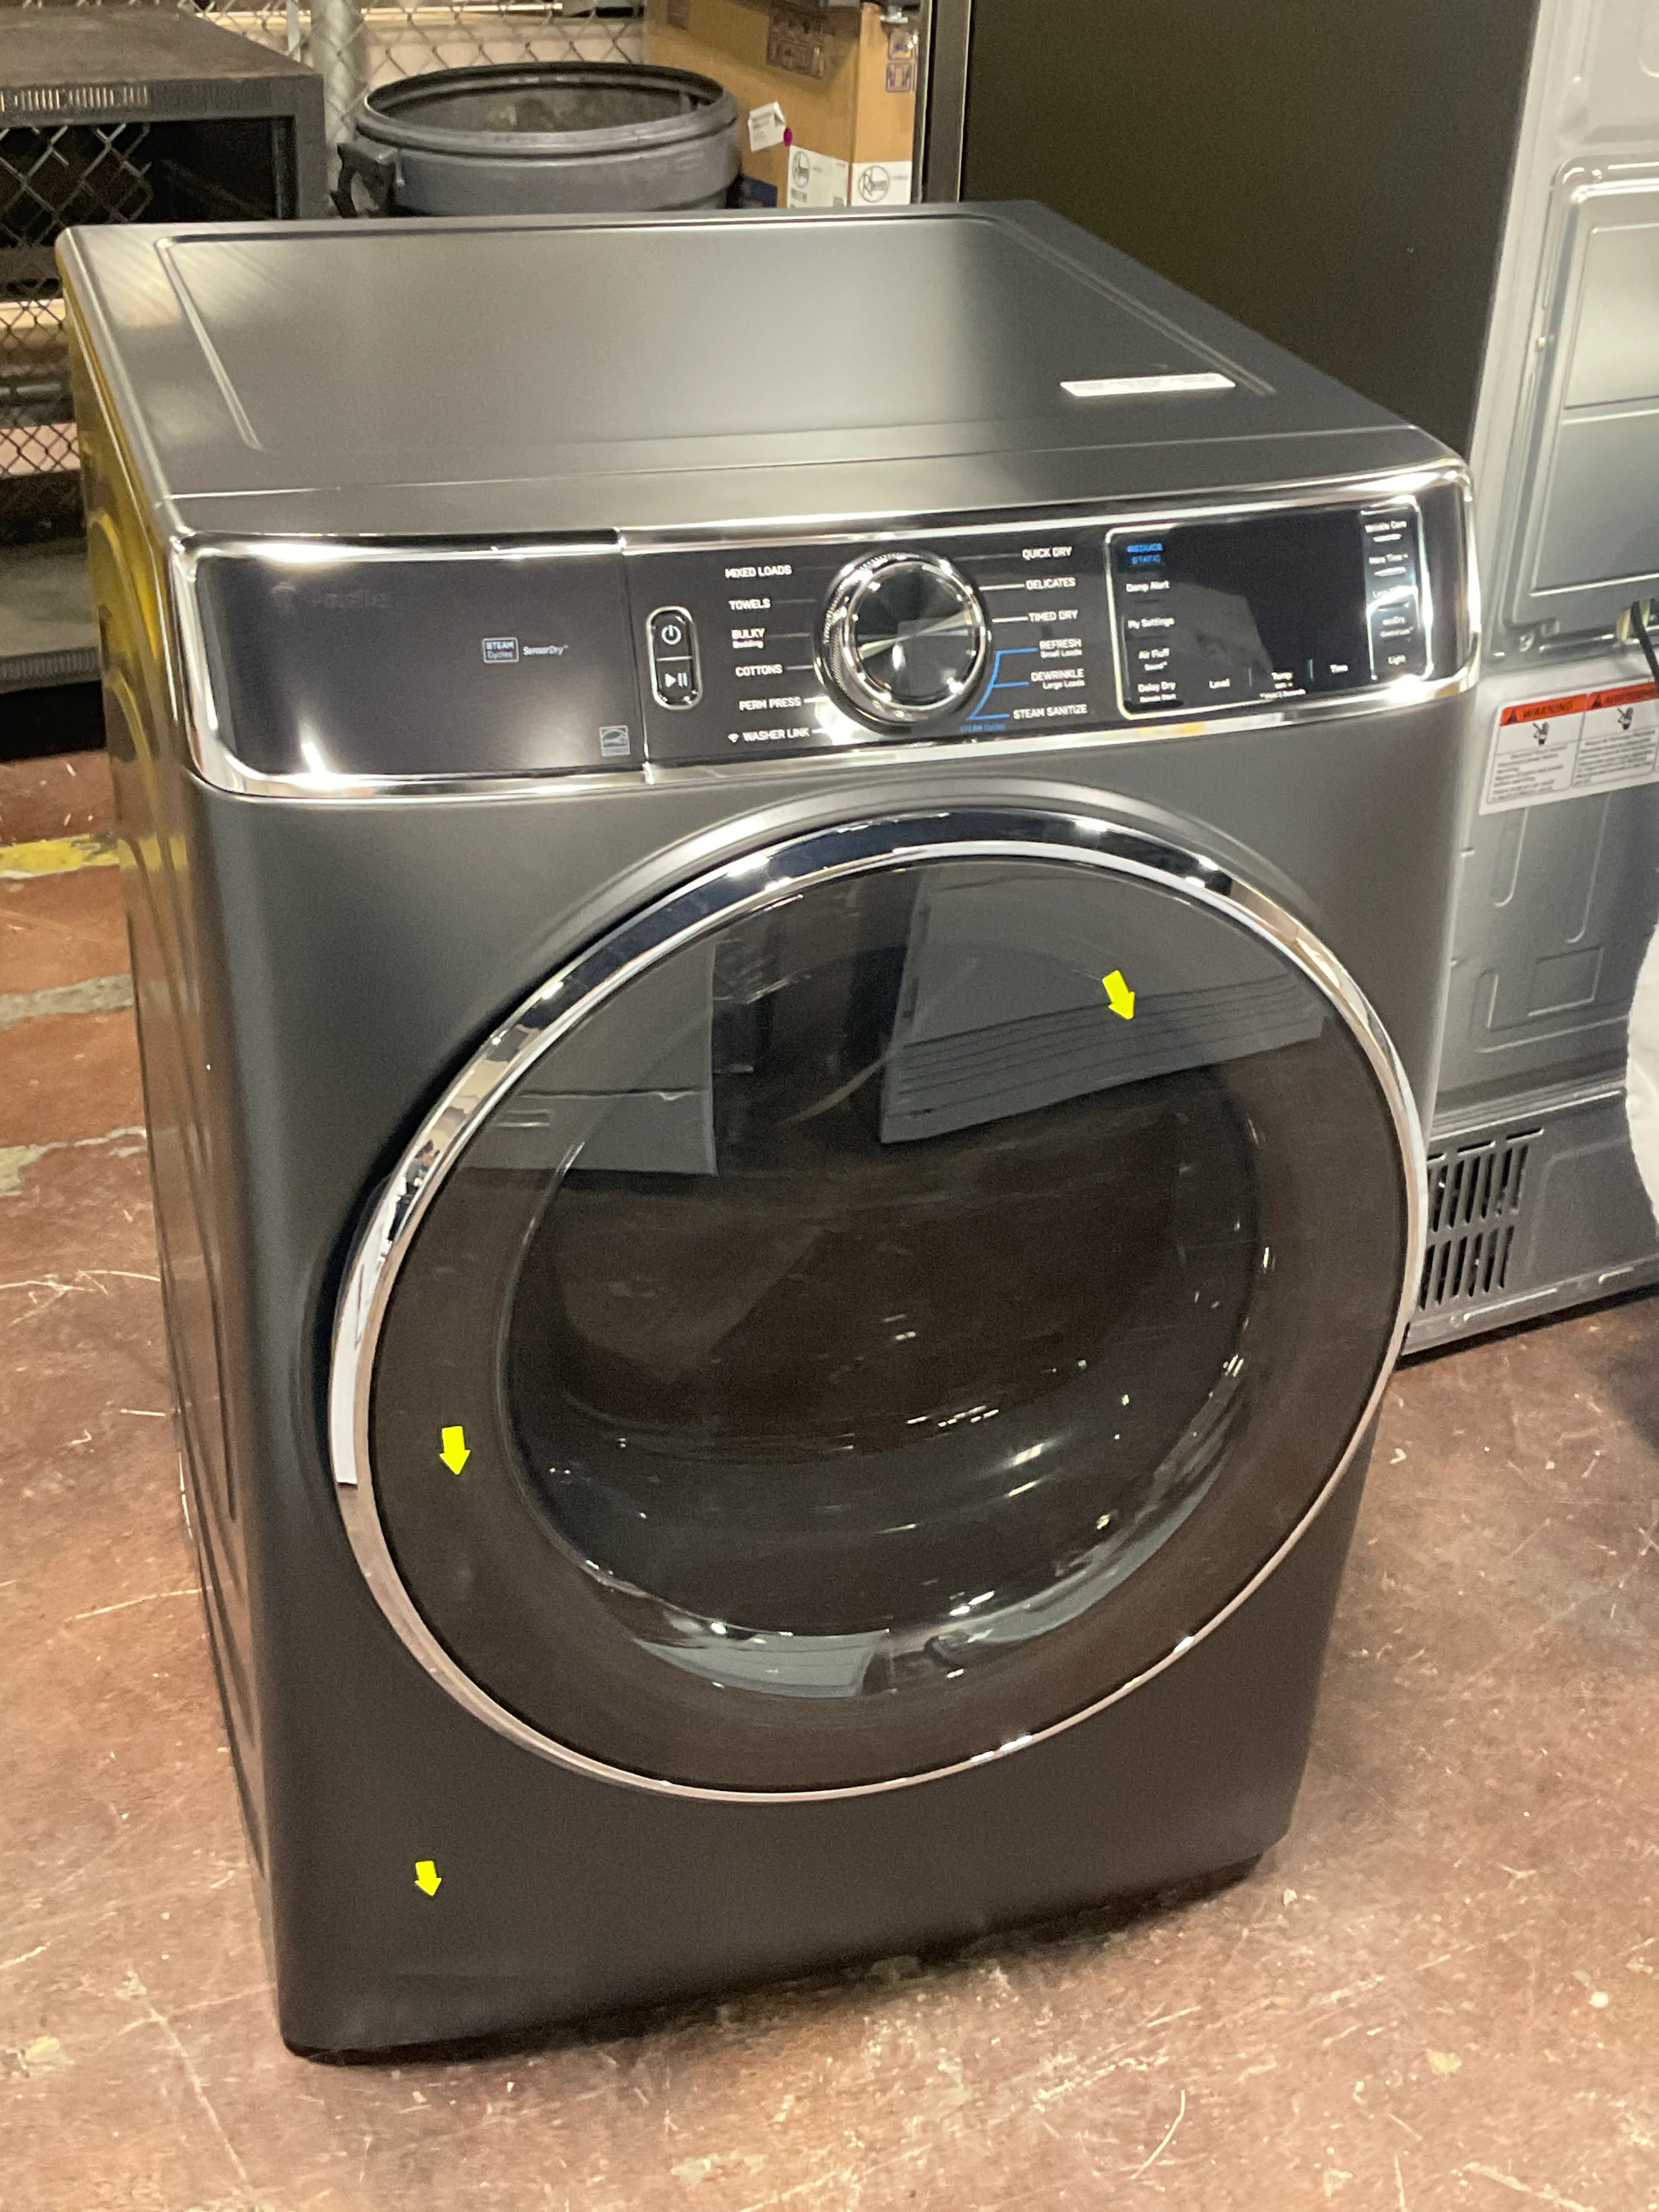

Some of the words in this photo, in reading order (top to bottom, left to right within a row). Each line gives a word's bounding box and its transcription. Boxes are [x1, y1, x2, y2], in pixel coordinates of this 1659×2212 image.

[1022, 548, 1051, 561] QUICK
[1052, 546, 1073, 557] DRY
[725, 567, 757, 579] MIXED
[758, 565, 792, 576] LOADS
[1026, 577, 1076, 590] DELICATES
[729, 598, 771, 611] TOWELS
[1028, 611, 1057, 623] TIMED
[1058, 610, 1079, 620] DRY
[731, 628, 765, 640] BULKY
[486, 641, 514, 650] STEAM
[1039, 639, 1082, 650] REFRESH
[735, 664, 783, 677] COTTONS
[1031, 668, 1085, 682] DEWRINKLE
[739, 699, 768, 711] PERM
[769, 696, 802, 709] PRESS
[1013, 708, 1045, 720] STEAM
[1046, 704, 1088, 716] SANITIZE
[742, 729, 786, 742] WASHER
[787, 727, 811, 738] LINK
